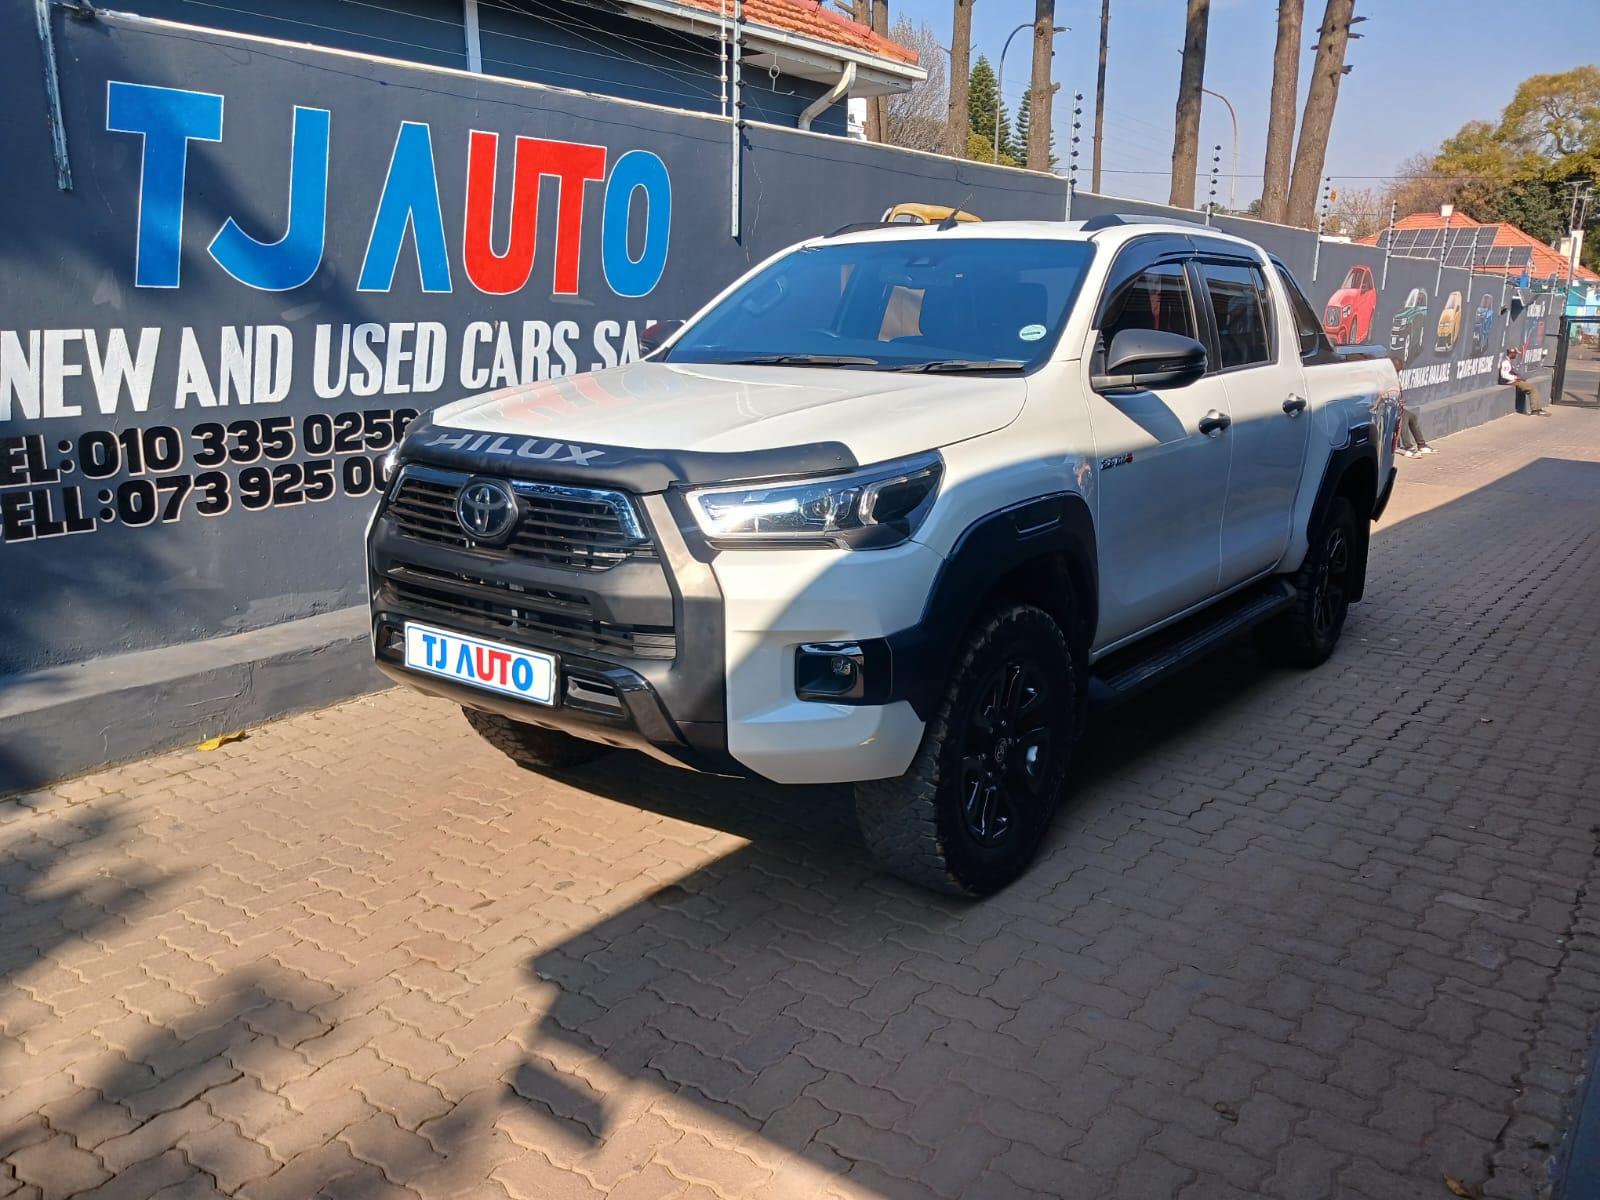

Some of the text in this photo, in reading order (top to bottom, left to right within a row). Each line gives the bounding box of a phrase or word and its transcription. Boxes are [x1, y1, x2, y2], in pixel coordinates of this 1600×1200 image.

[106, 80, 672, 298] TJ AUTO
[0, 327, 162, 421] NEW
[174, 325, 294, 409] AND
[313, 321, 447, 399] USED
[460, 319, 580, 390] CARS
[190, 417, 297, 468] 335
[423, 432, 606, 466] HILUX
[239, 459, 337, 511] 925
[422, 634, 534, 692] TJ AUTO
